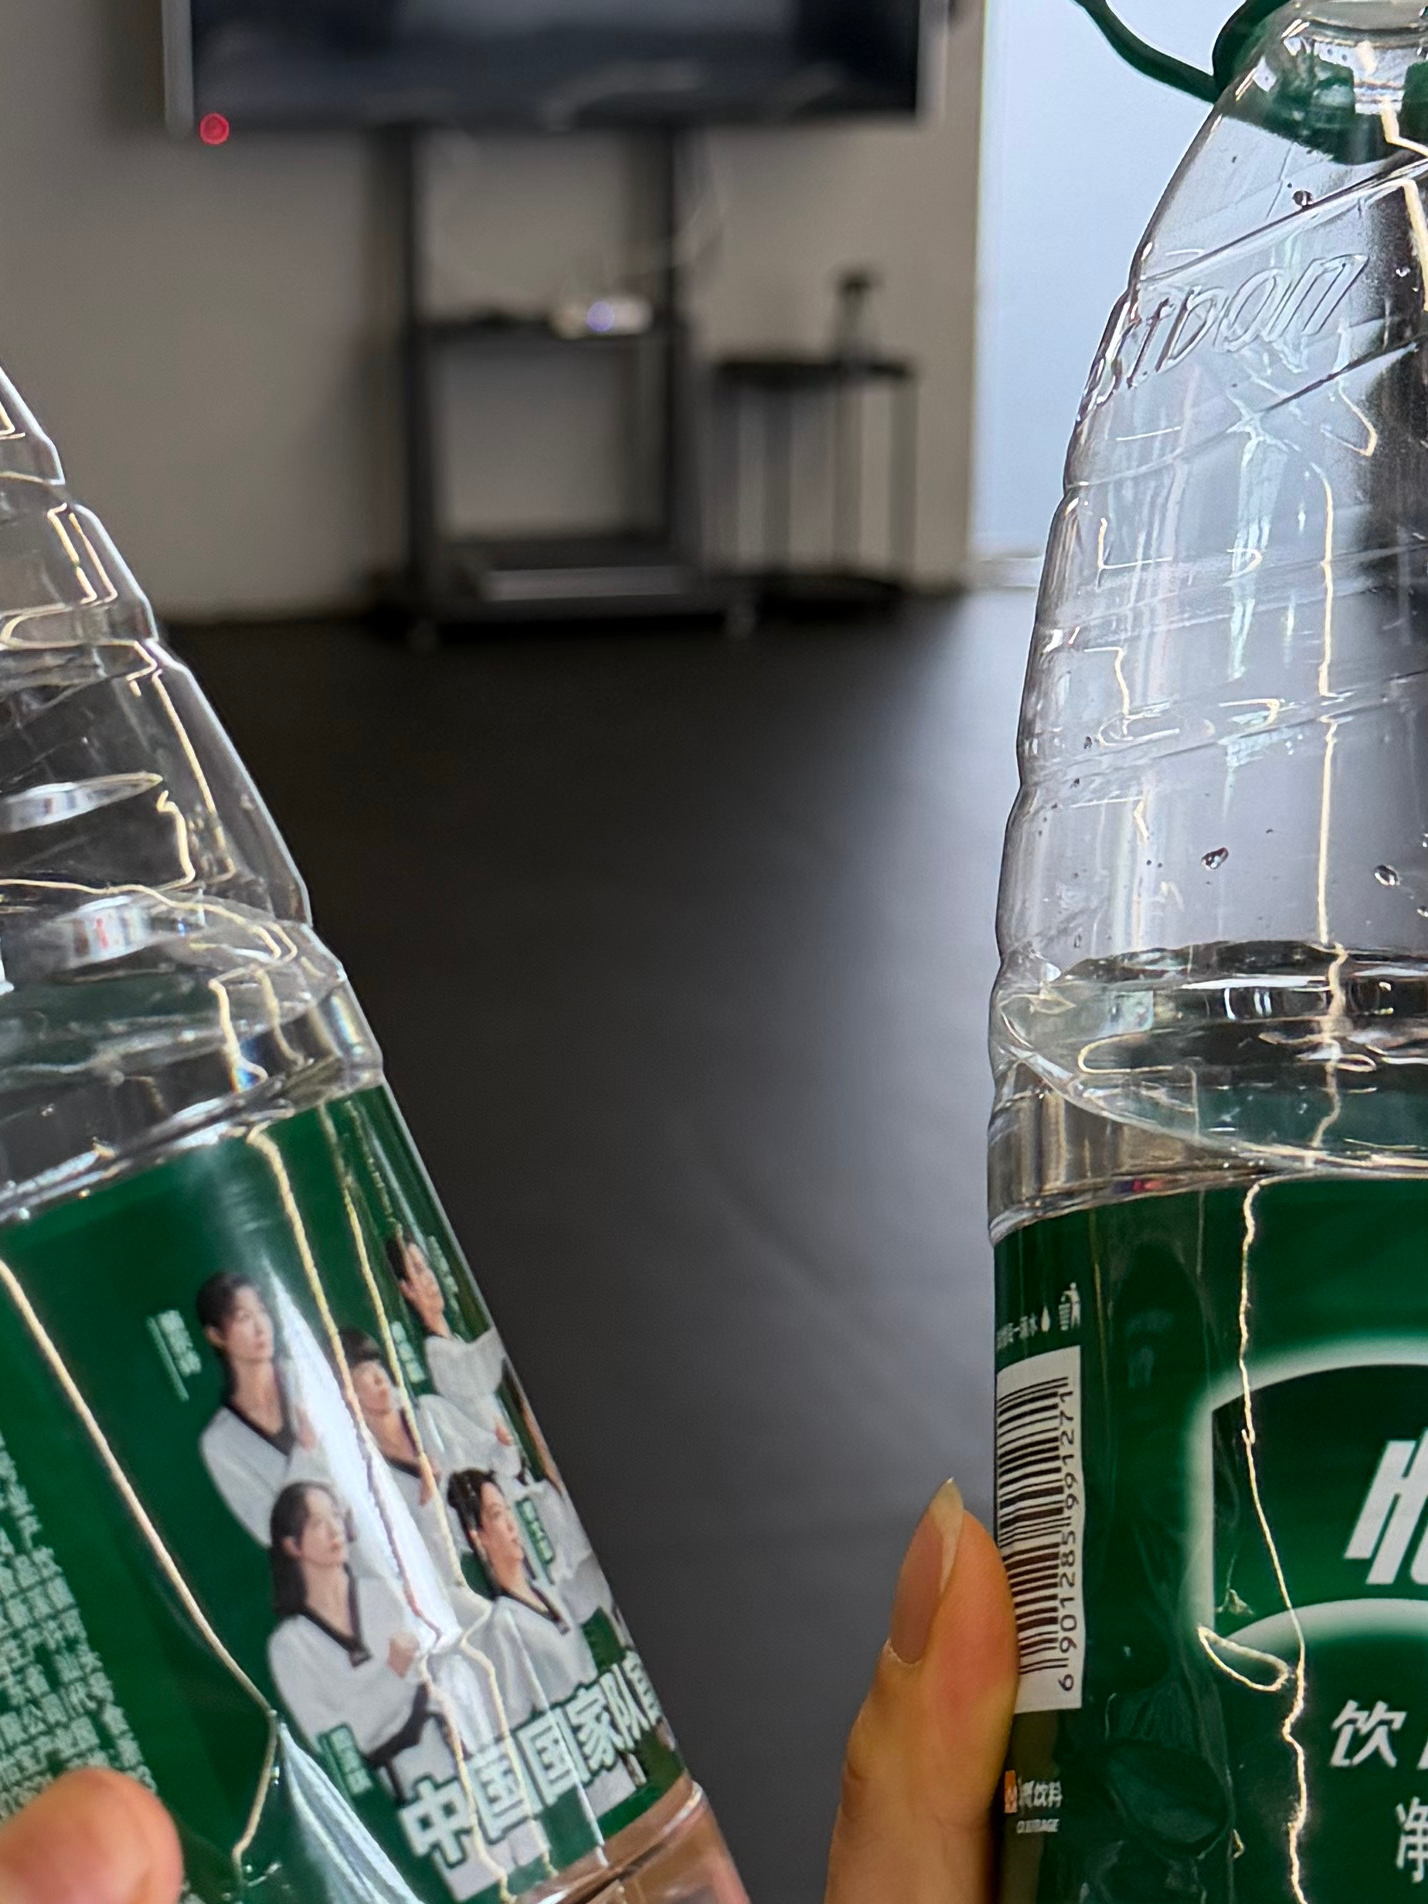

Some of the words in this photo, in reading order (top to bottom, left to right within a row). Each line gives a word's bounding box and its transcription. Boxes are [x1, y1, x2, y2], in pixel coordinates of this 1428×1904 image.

[1059, 1390, 1079, 1510] 991271
[1059, 1530, 1078, 1653] 901285
[1059, 1674, 1074, 1691] 6
